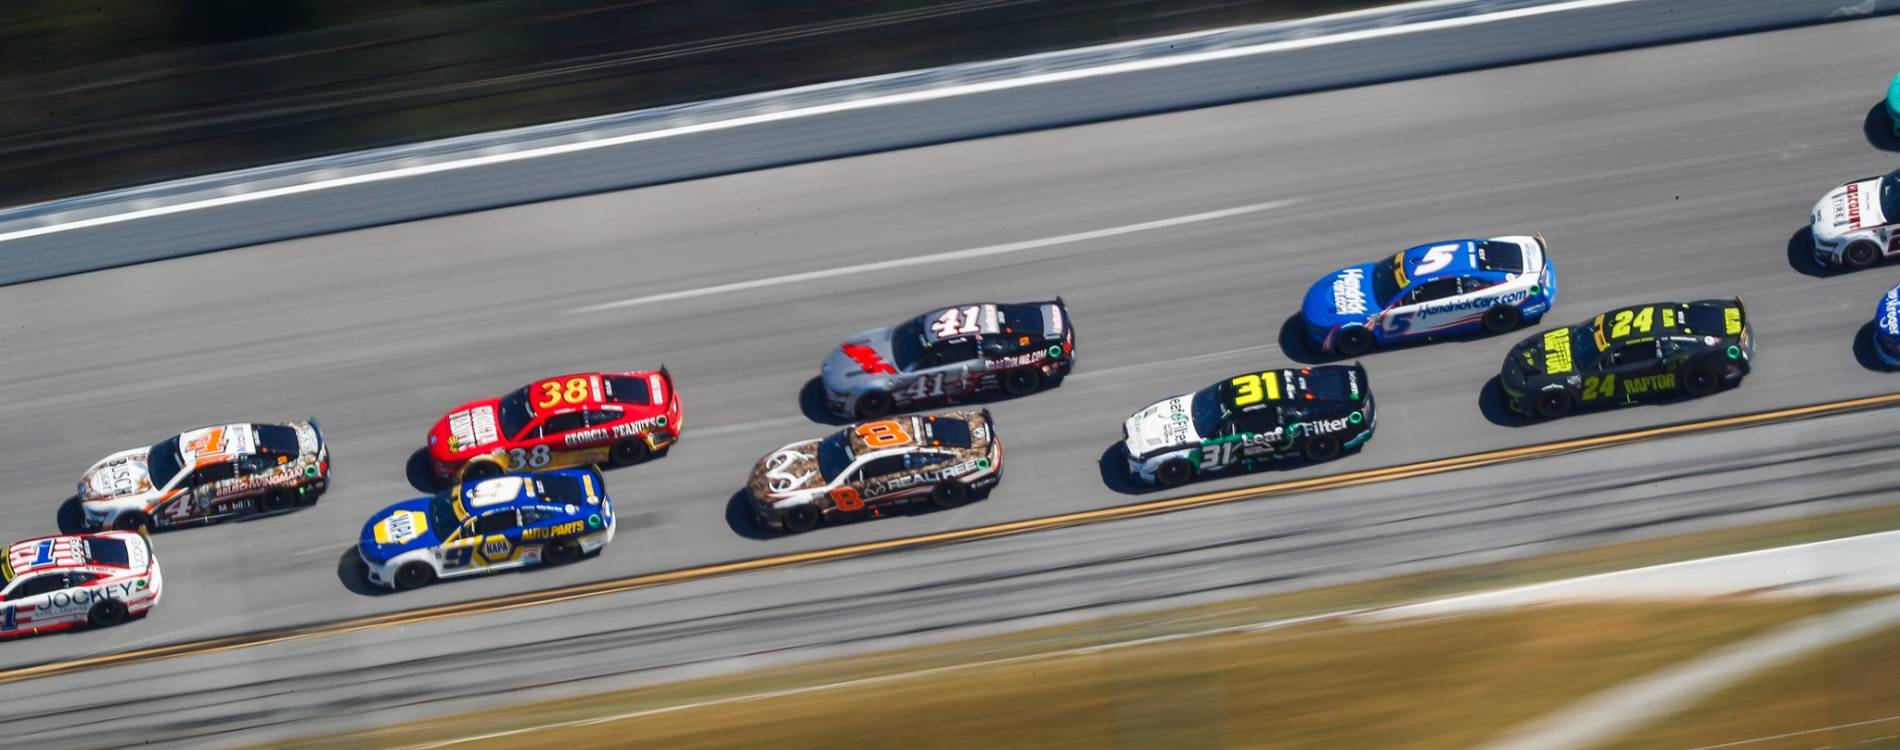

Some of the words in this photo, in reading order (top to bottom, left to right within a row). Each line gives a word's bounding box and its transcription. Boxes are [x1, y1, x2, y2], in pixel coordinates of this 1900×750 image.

[1834, 198, 1844, 218] TIRE
[1414, 244, 1459, 276] 5
[1418, 290, 1527, 319] HendrickCars.com
[931, 306, 979, 338] 41
[1383, 311, 1415, 336] 5
[1612, 307, 1654, 338] 24
[539, 378, 588, 408] 38
[906, 372, 944, 400] 41
[1232, 371, 1281, 406] 31
[1583, 373, 1616, 400] 24
[1624, 373, 1676, 394] RAPTOR
[565, 428, 609, 445] GEORGIA
[612, 416, 657, 438] PEANUTS
[855, 420, 912, 448] 8
[1242, 426, 1283, 446] Leaf
[1302, 416, 1349, 437] Filter
[508, 444, 551, 472] 38
[1200, 441, 1232, 468] 31
[109, 458, 133, 497] BUSCH
[887, 459, 977, 490] REALTREE
[165, 494, 192, 518] 4
[831, 486, 865, 511] 8
[522, 527, 551, 541] AUTO
[551, 520, 584, 537] PARTS
[29, 538, 55, 567] 1
[443, 545, 473, 570] 9
[486, 541, 509, 556] NAPA
[37, 581, 133, 611] JOCKEY
[2, 604, 17, 631] 1
